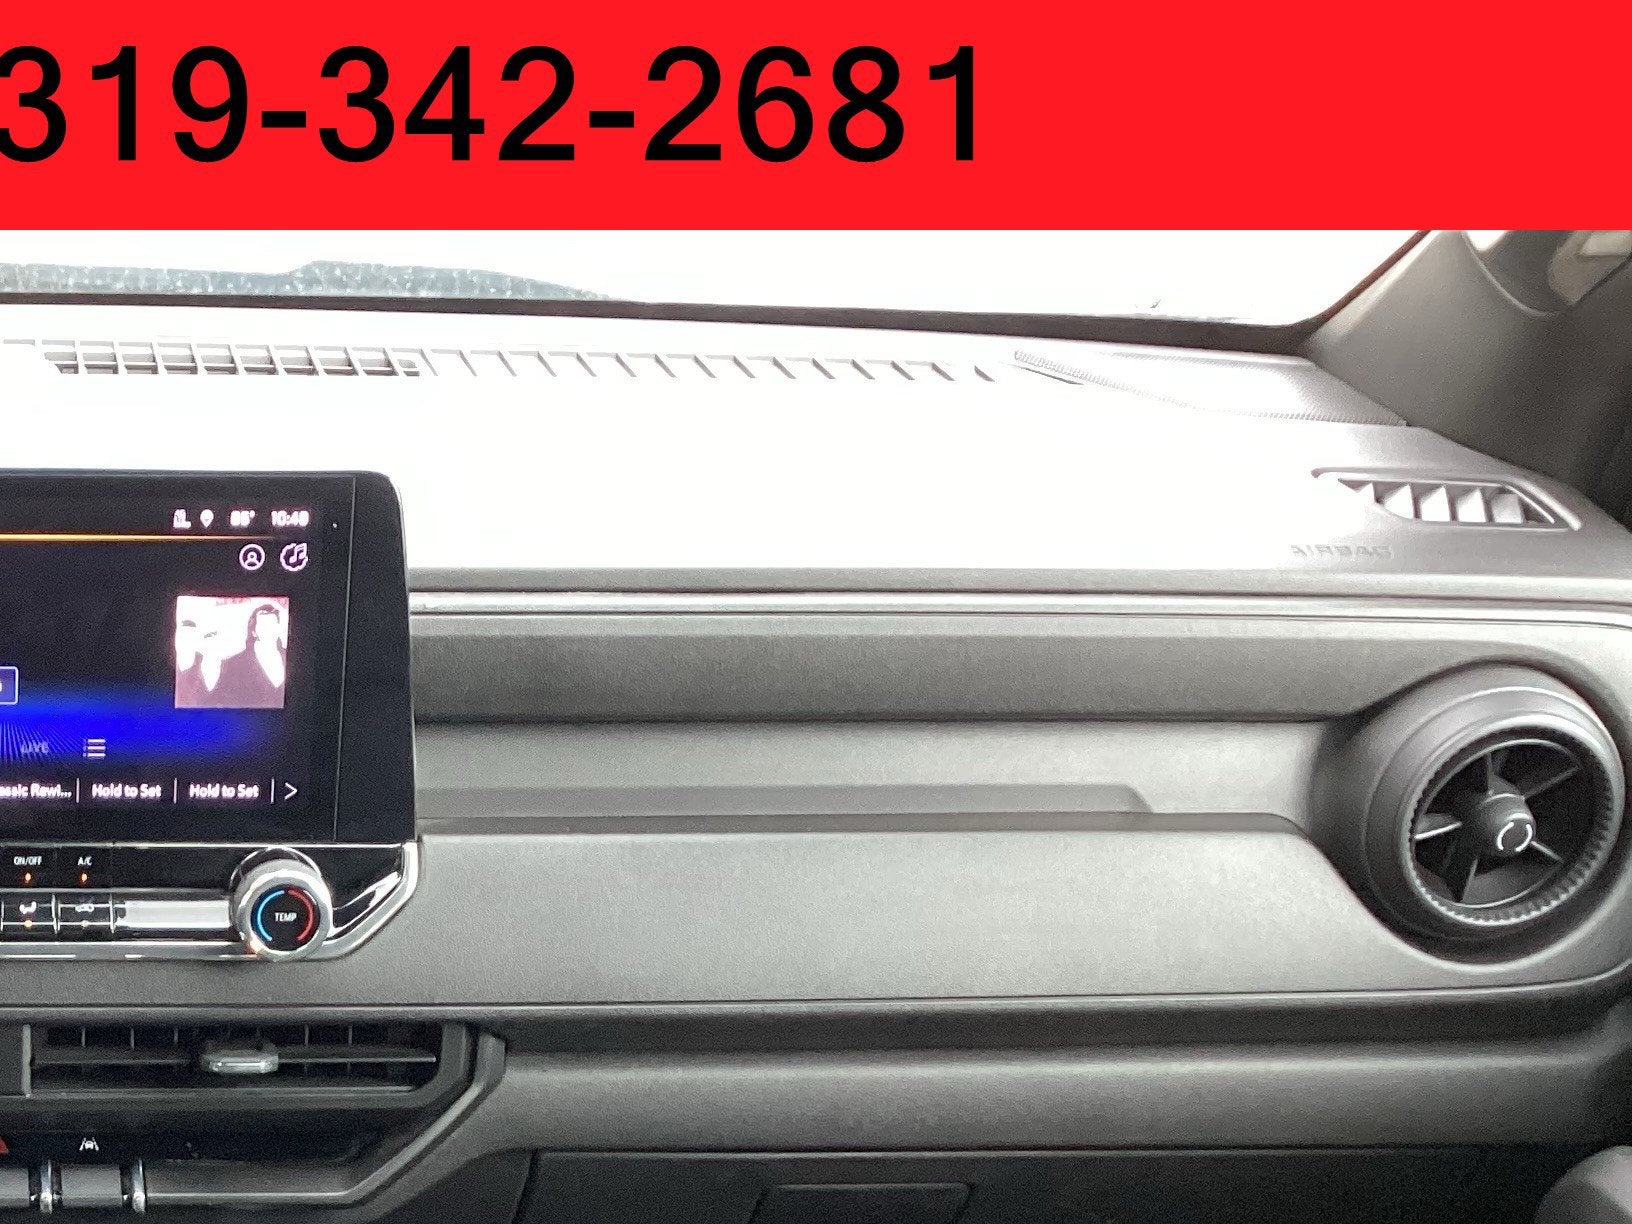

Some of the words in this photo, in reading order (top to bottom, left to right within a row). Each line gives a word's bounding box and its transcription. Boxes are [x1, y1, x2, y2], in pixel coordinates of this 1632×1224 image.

[91, 783, 122, 798] Hold
[124, 786, 139, 798] to
[140, 784, 162, 799] Set
[189, 783, 219, 798] Hold
[221, 786, 236, 798] to
[237, 784, 260, 799] Set
[13, 856, 43, 866] ON/OFF
[77, 856, 94, 867] A/C
[274, 911, 298, 923] TEMP
